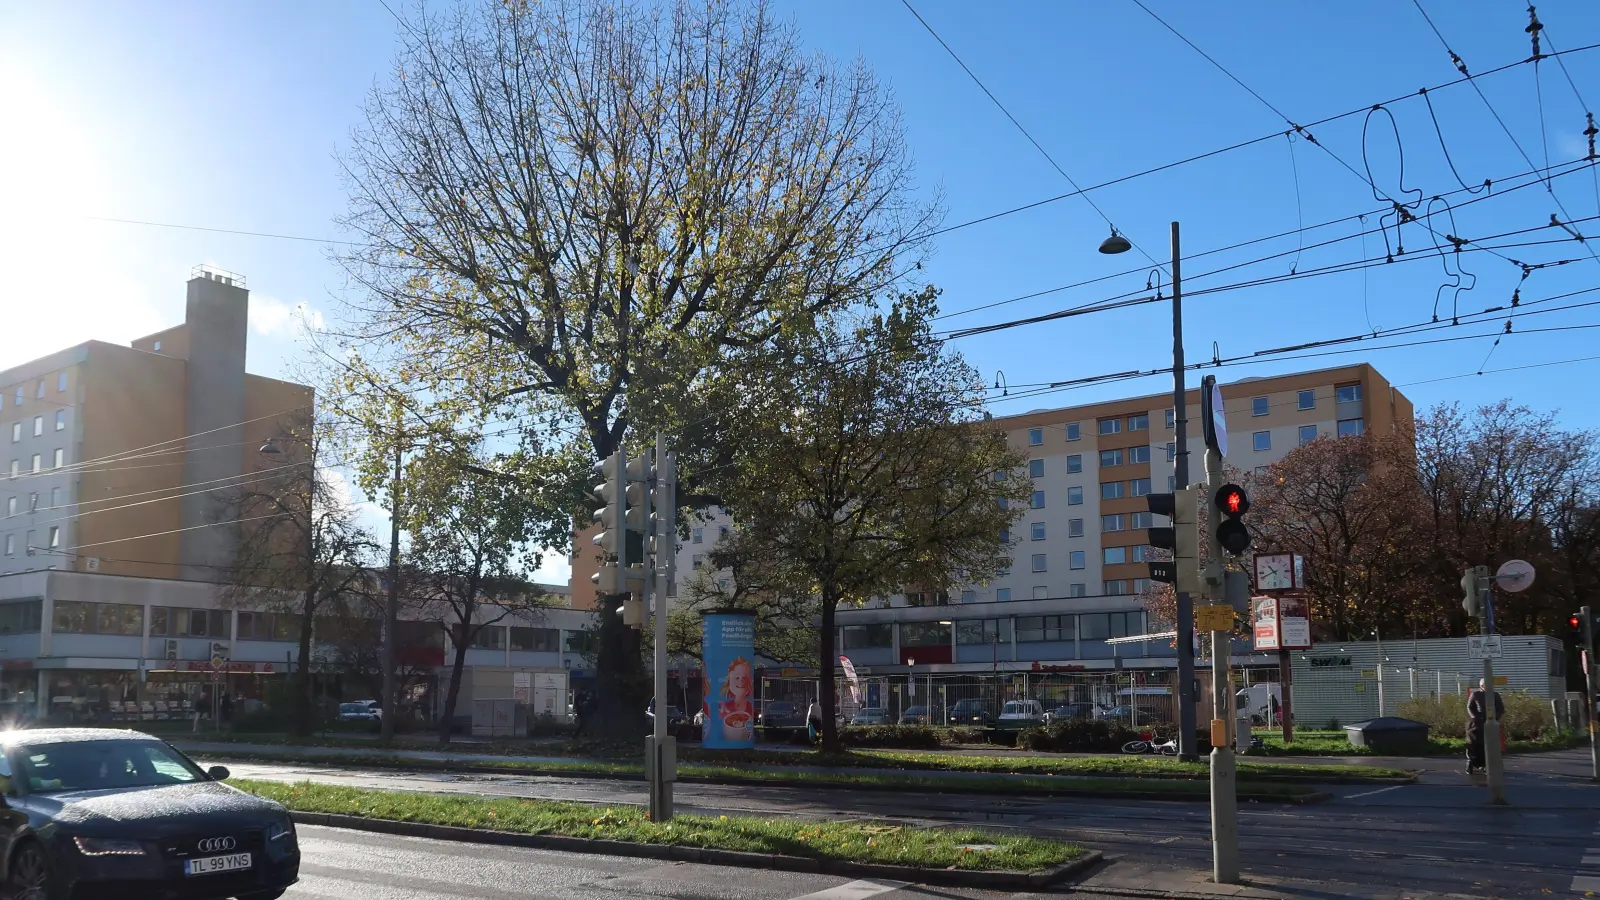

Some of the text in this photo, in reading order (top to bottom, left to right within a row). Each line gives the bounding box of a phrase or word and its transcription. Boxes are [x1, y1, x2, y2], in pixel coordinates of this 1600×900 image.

[192, 854, 249, 873] TL 99 YNS
